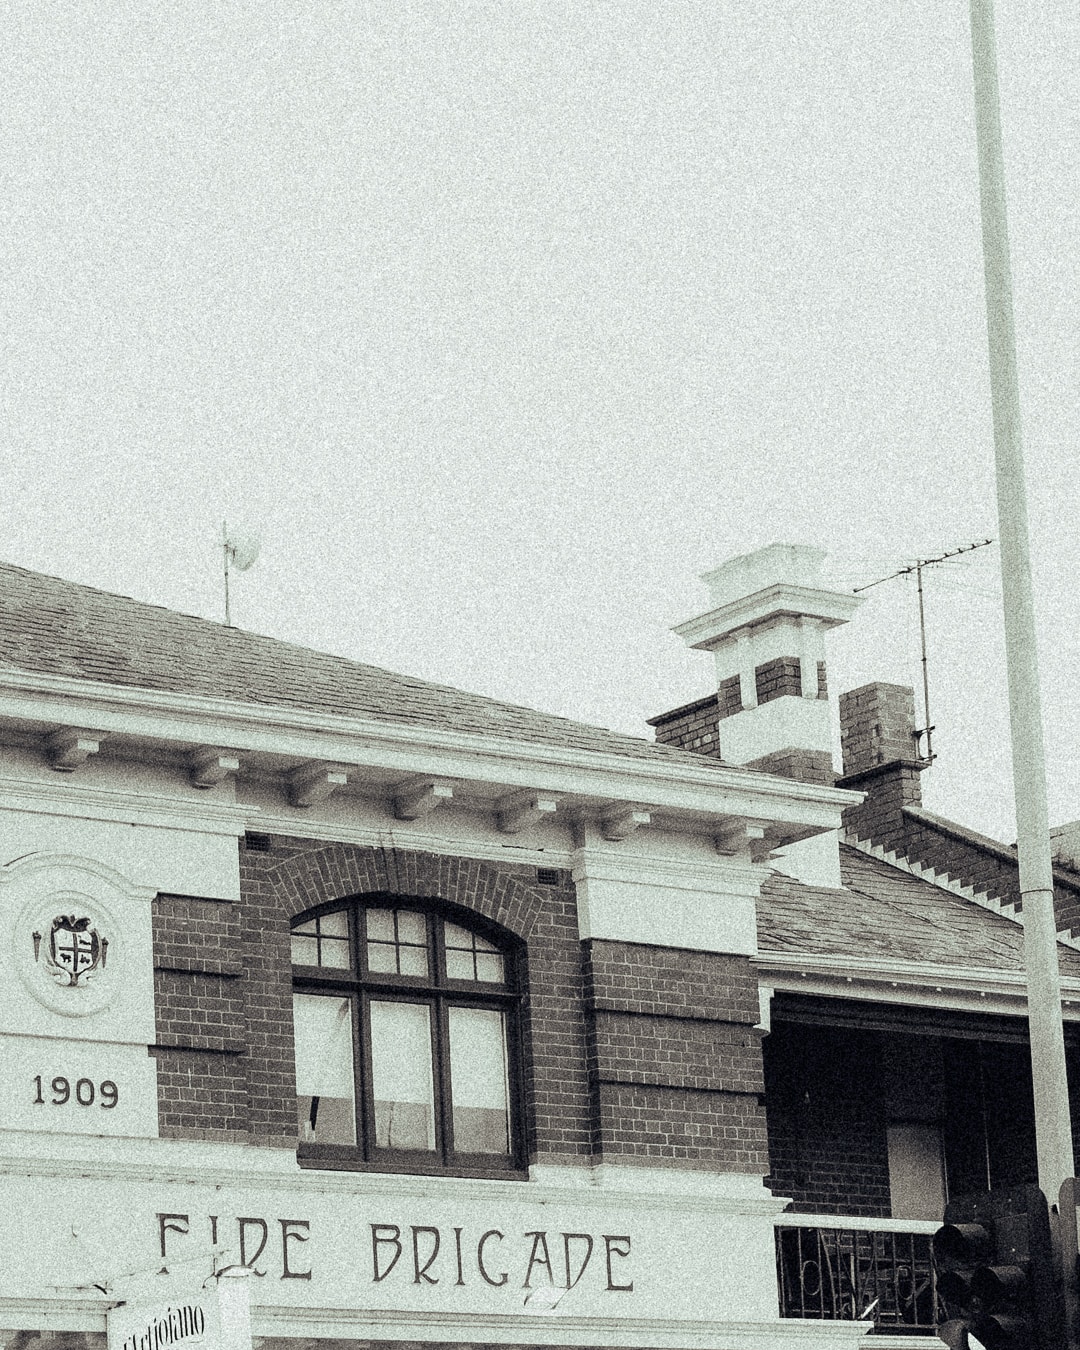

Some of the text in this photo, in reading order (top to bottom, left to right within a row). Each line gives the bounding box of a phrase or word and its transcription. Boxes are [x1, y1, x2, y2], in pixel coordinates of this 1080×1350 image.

[33, 1075, 119, 1109] 1909
[156, 1213, 312, 1280] FIRE
[370, 1223, 634, 1292] BRIGADE
